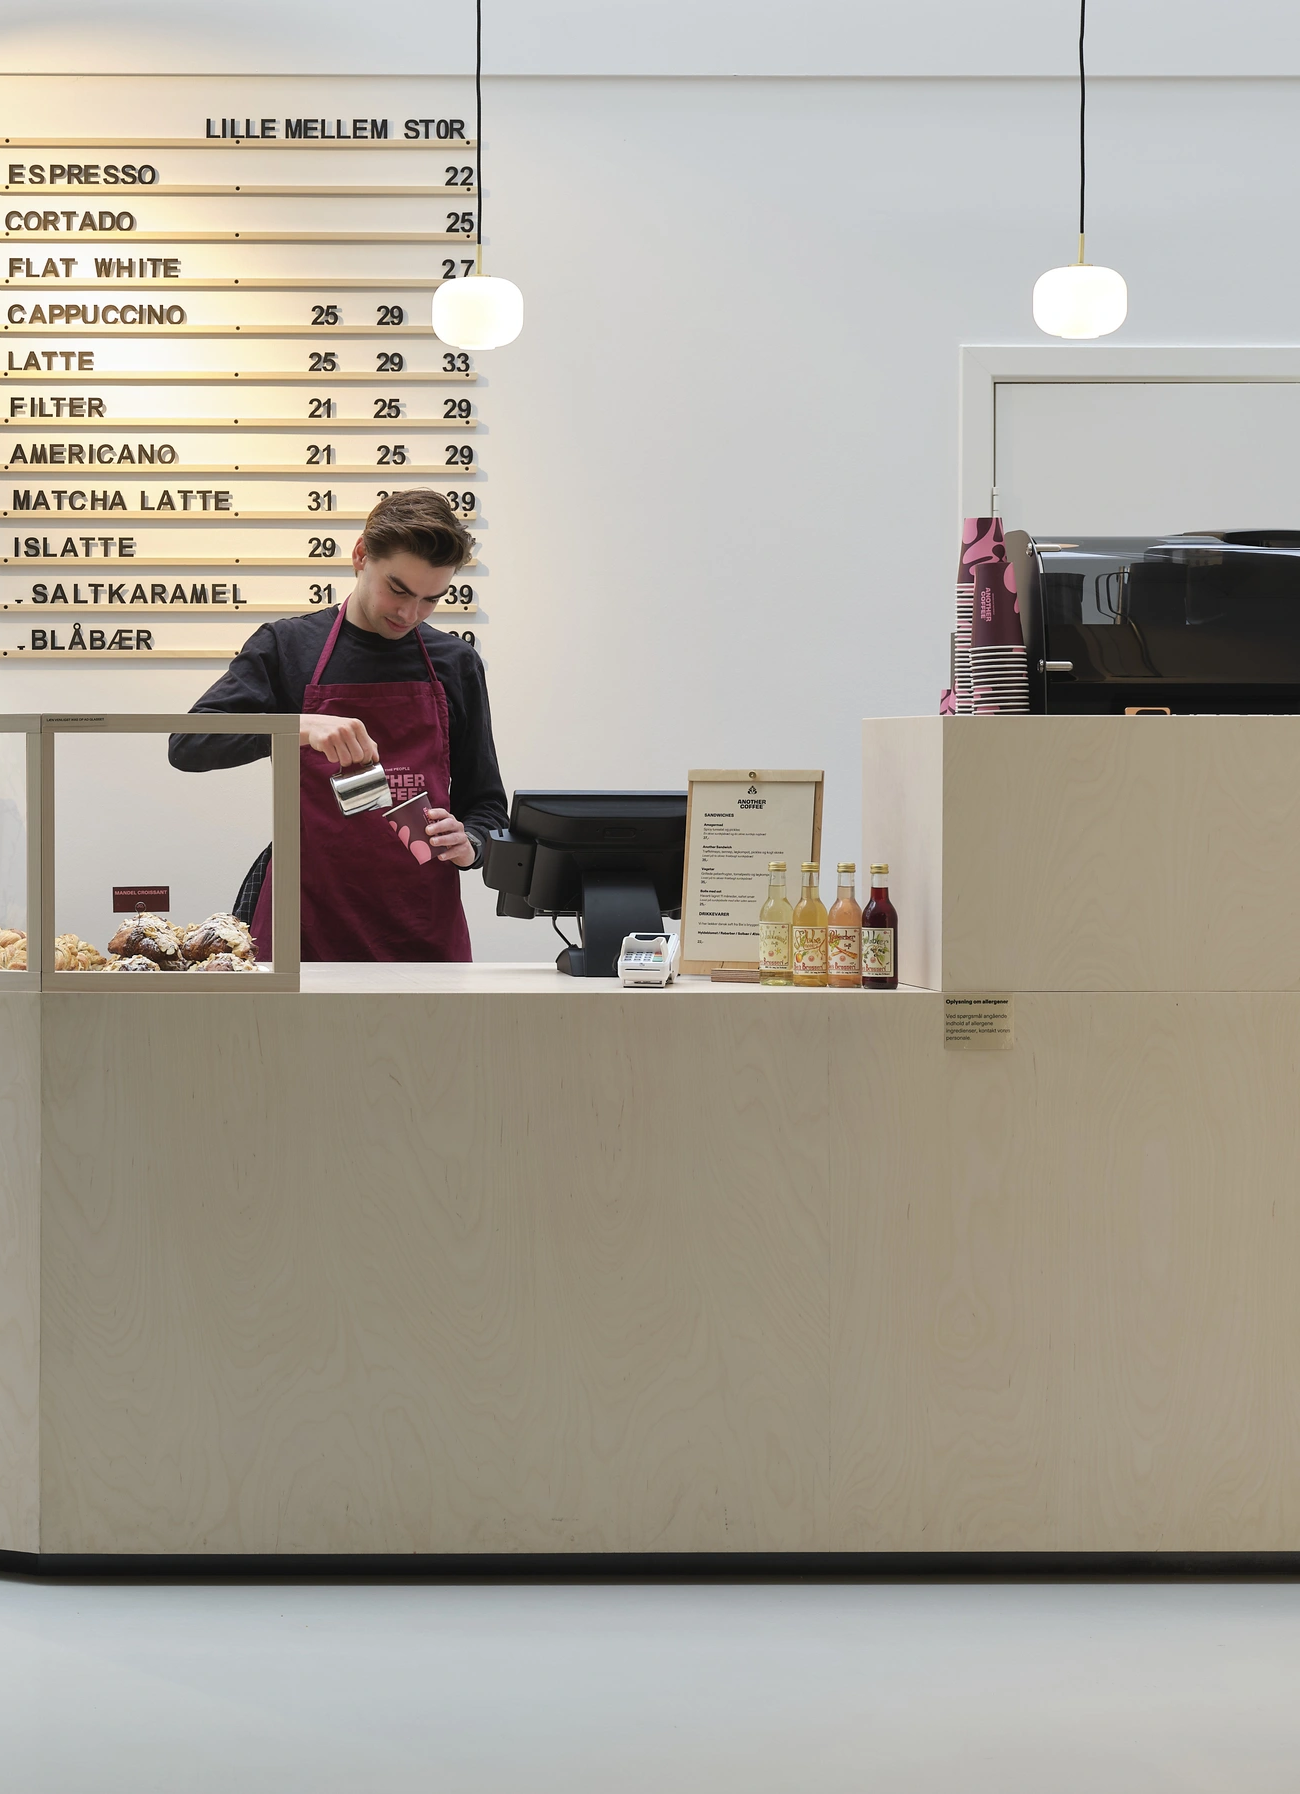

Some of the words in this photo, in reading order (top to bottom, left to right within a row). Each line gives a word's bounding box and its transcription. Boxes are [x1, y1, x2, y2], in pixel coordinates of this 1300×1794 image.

[206, 118, 277, 139] LILLE
[286, 119, 387, 139] MELLEM
[9, 165, 155, 184] ESPRESSO
[446, 167, 473, 186] 22
[5, 211, 133, 231] CORTADO
[446, 212, 474, 232] 25
[10, 258, 75, 277] FLAT
[95, 258, 178, 277] WHITE
[442, 259, 474, 279] 27
[8, 305, 184, 324] CAPPUCCINO
[312, 305, 338, 325] 25
[377, 306, 403, 325] 29
[9, 352, 93, 370] LATTE
[309, 353, 336, 371] 25
[377, 353, 403, 371] 29
[443, 353, 469, 372] 33
[11, 398, 103, 417] FILTER
[309, 399, 331, 418] 21
[374, 399, 400, 418] 25
[444, 399, 471, 418] 29
[10, 444, 175, 464] AMERICANO
[307, 445, 331, 464] 21
[377, 445, 406, 464] 25
[446, 445, 473, 465] 29
[13, 490, 126, 510] MATCHA
[141, 490, 229, 510] LATTE
[308, 491, 331, 511] 31
[15, 537, 133, 557] ISLATTE
[309, 538, 336, 557] 29
[32, 584, 246, 603] SALTKARAMEL
[309, 584, 333, 604] 31
[32, 623, 152, 650] BLÅBÆR
